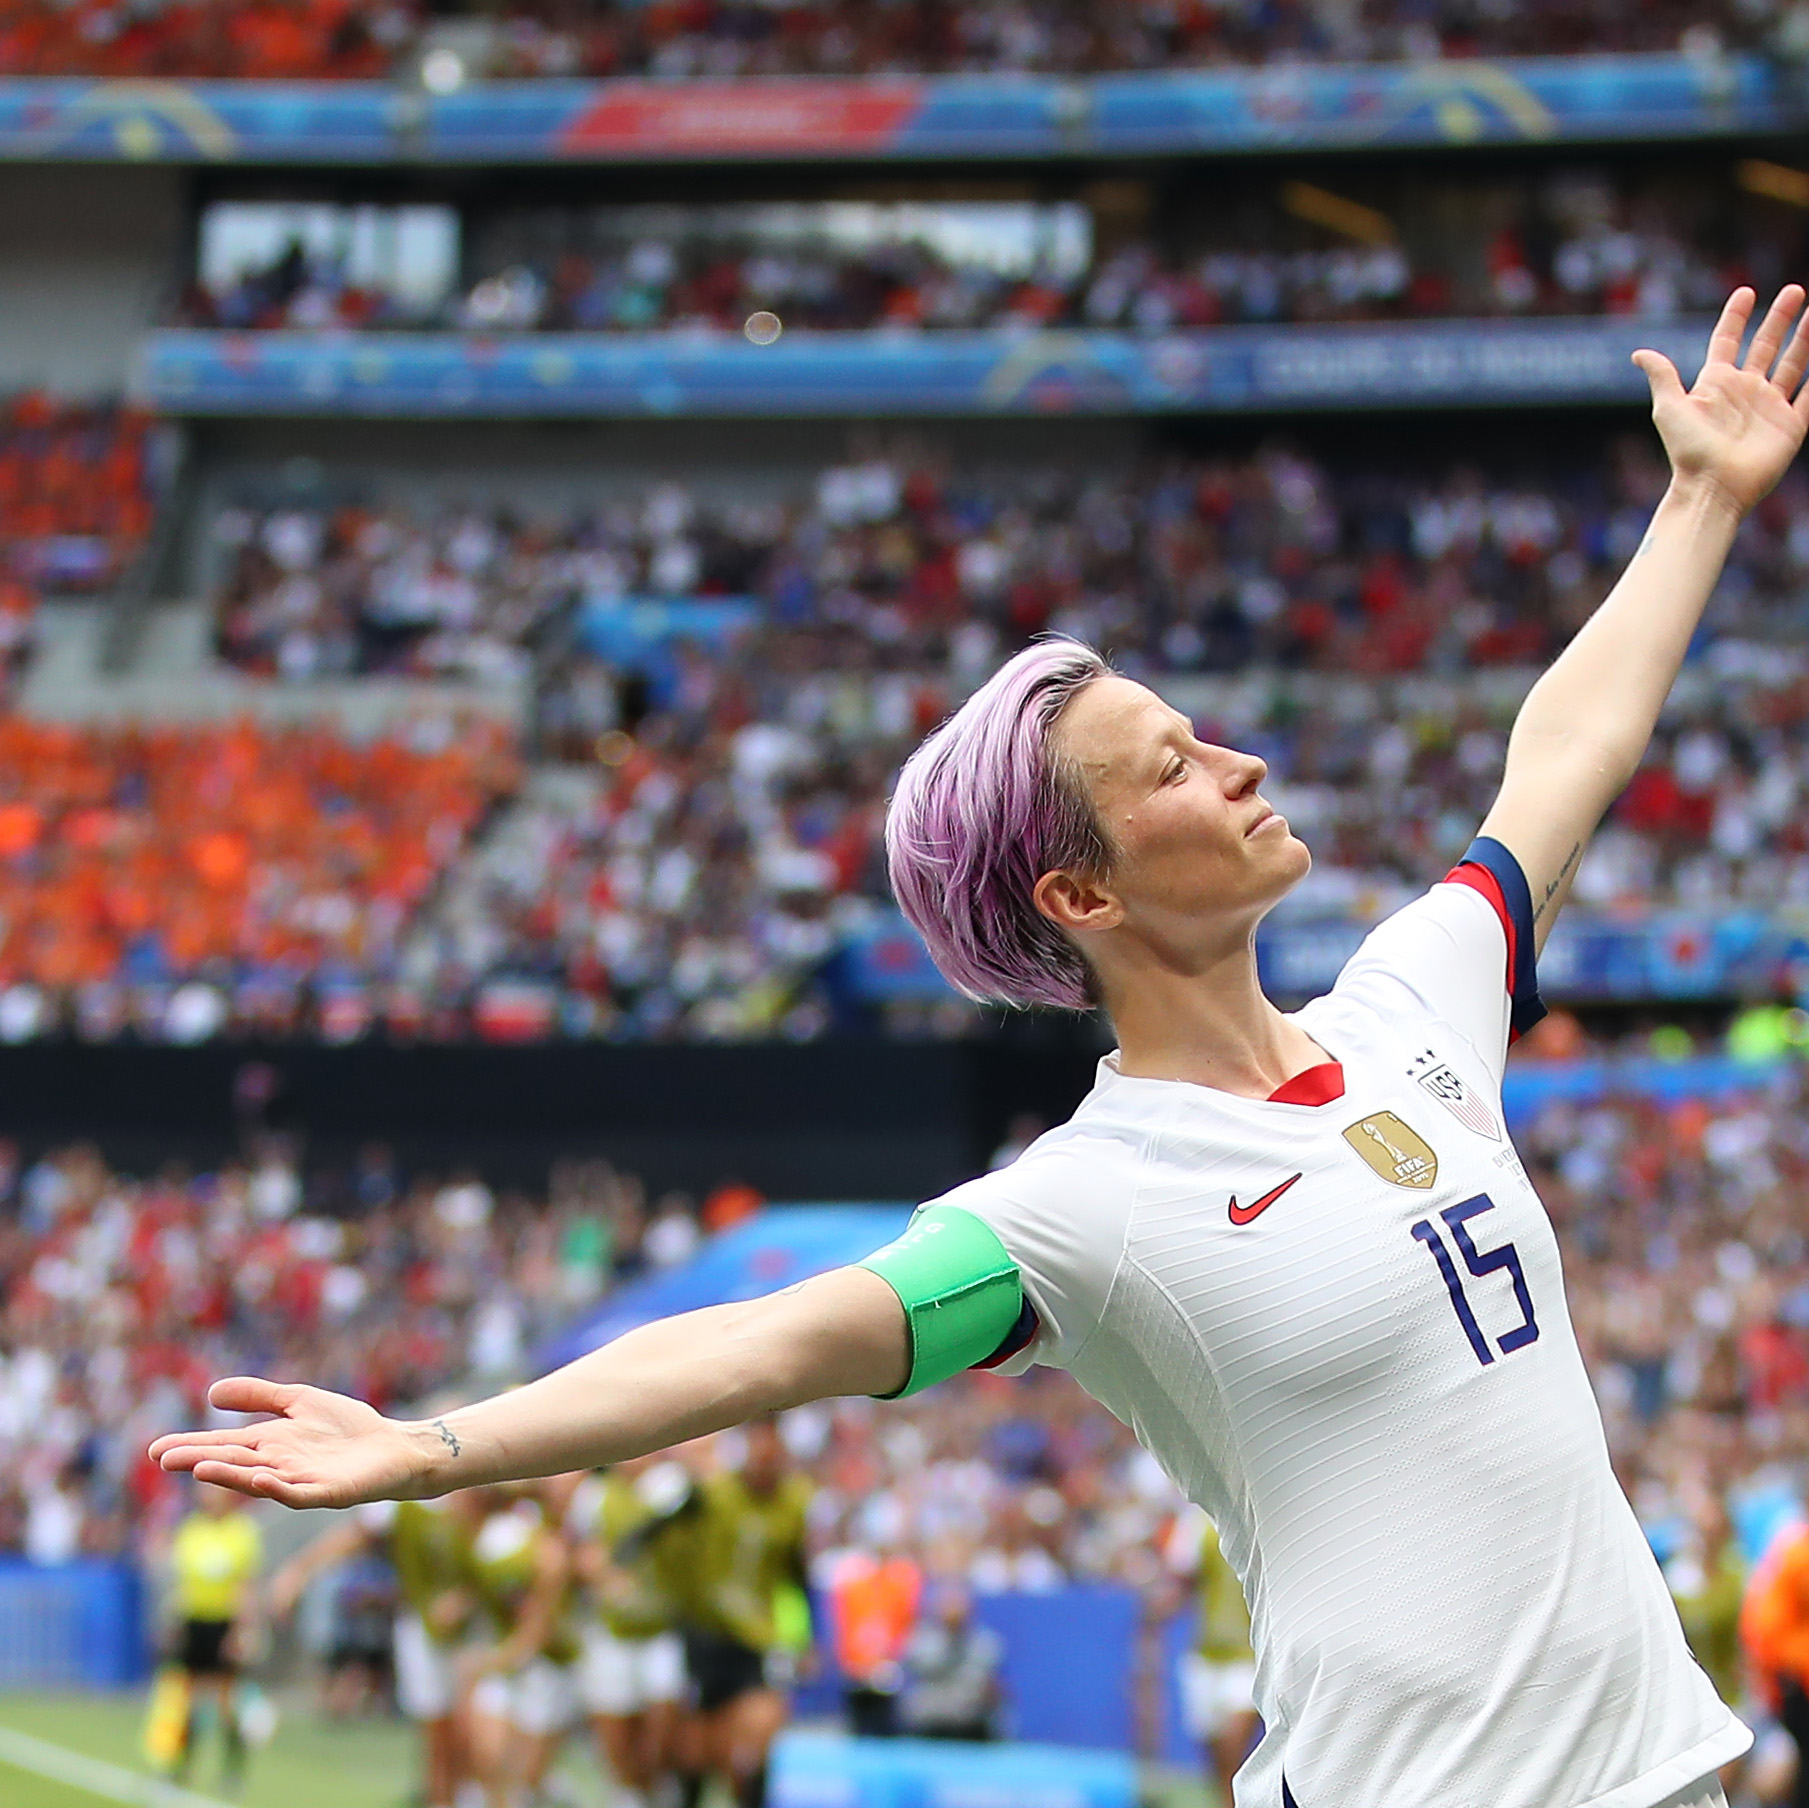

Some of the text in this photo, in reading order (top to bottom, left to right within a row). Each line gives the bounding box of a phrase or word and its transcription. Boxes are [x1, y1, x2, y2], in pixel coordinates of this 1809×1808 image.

[1426, 1070, 1464, 1101] USA
[1393, 1157, 1426, 1177] FIFA
[1410, 1192, 1540, 1367] 15
